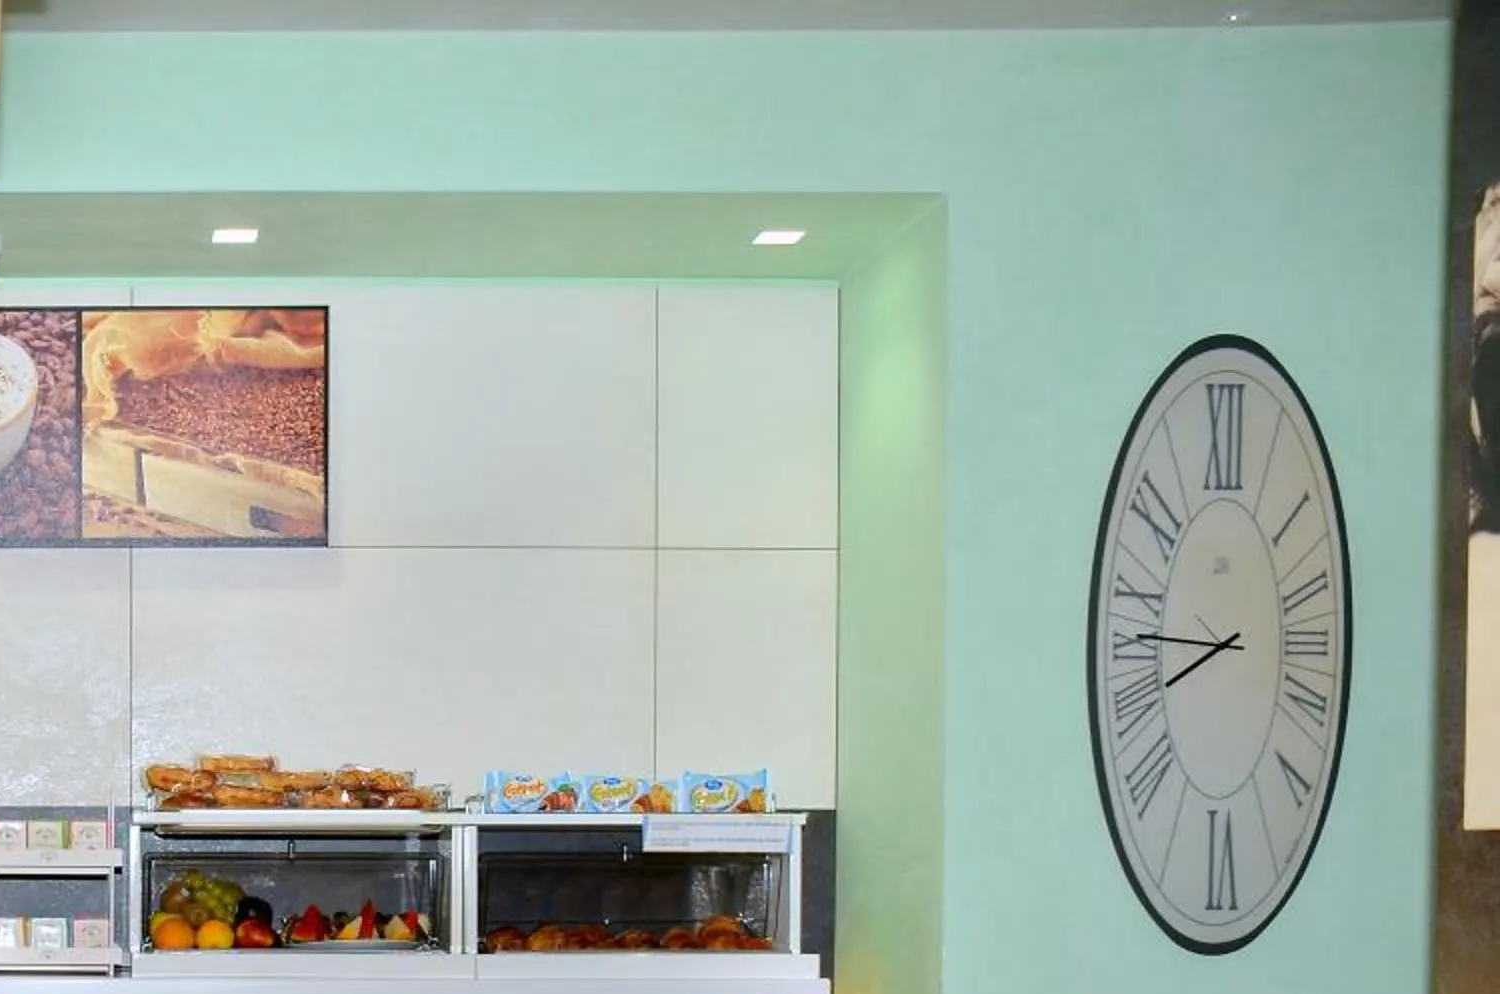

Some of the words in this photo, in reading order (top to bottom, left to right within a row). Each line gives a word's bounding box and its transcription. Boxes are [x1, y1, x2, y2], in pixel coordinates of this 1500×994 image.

[1203, 383, 1246, 490] XII
[1130, 470, 1183, 564] XI
[1272, 488, 1311, 547] I
[1114, 572, 1164, 618] X
[1282, 570, 1329, 616] II
[1113, 630, 1159, 661] IX
[1284, 629, 1329, 657] III
[1114, 669, 1161, 739] VIII
[1284, 672, 1327, 728] IV
[1125, 728, 1174, 820] VII
[1275, 750, 1312, 809] V
[1204, 806, 1239, 911] VI
